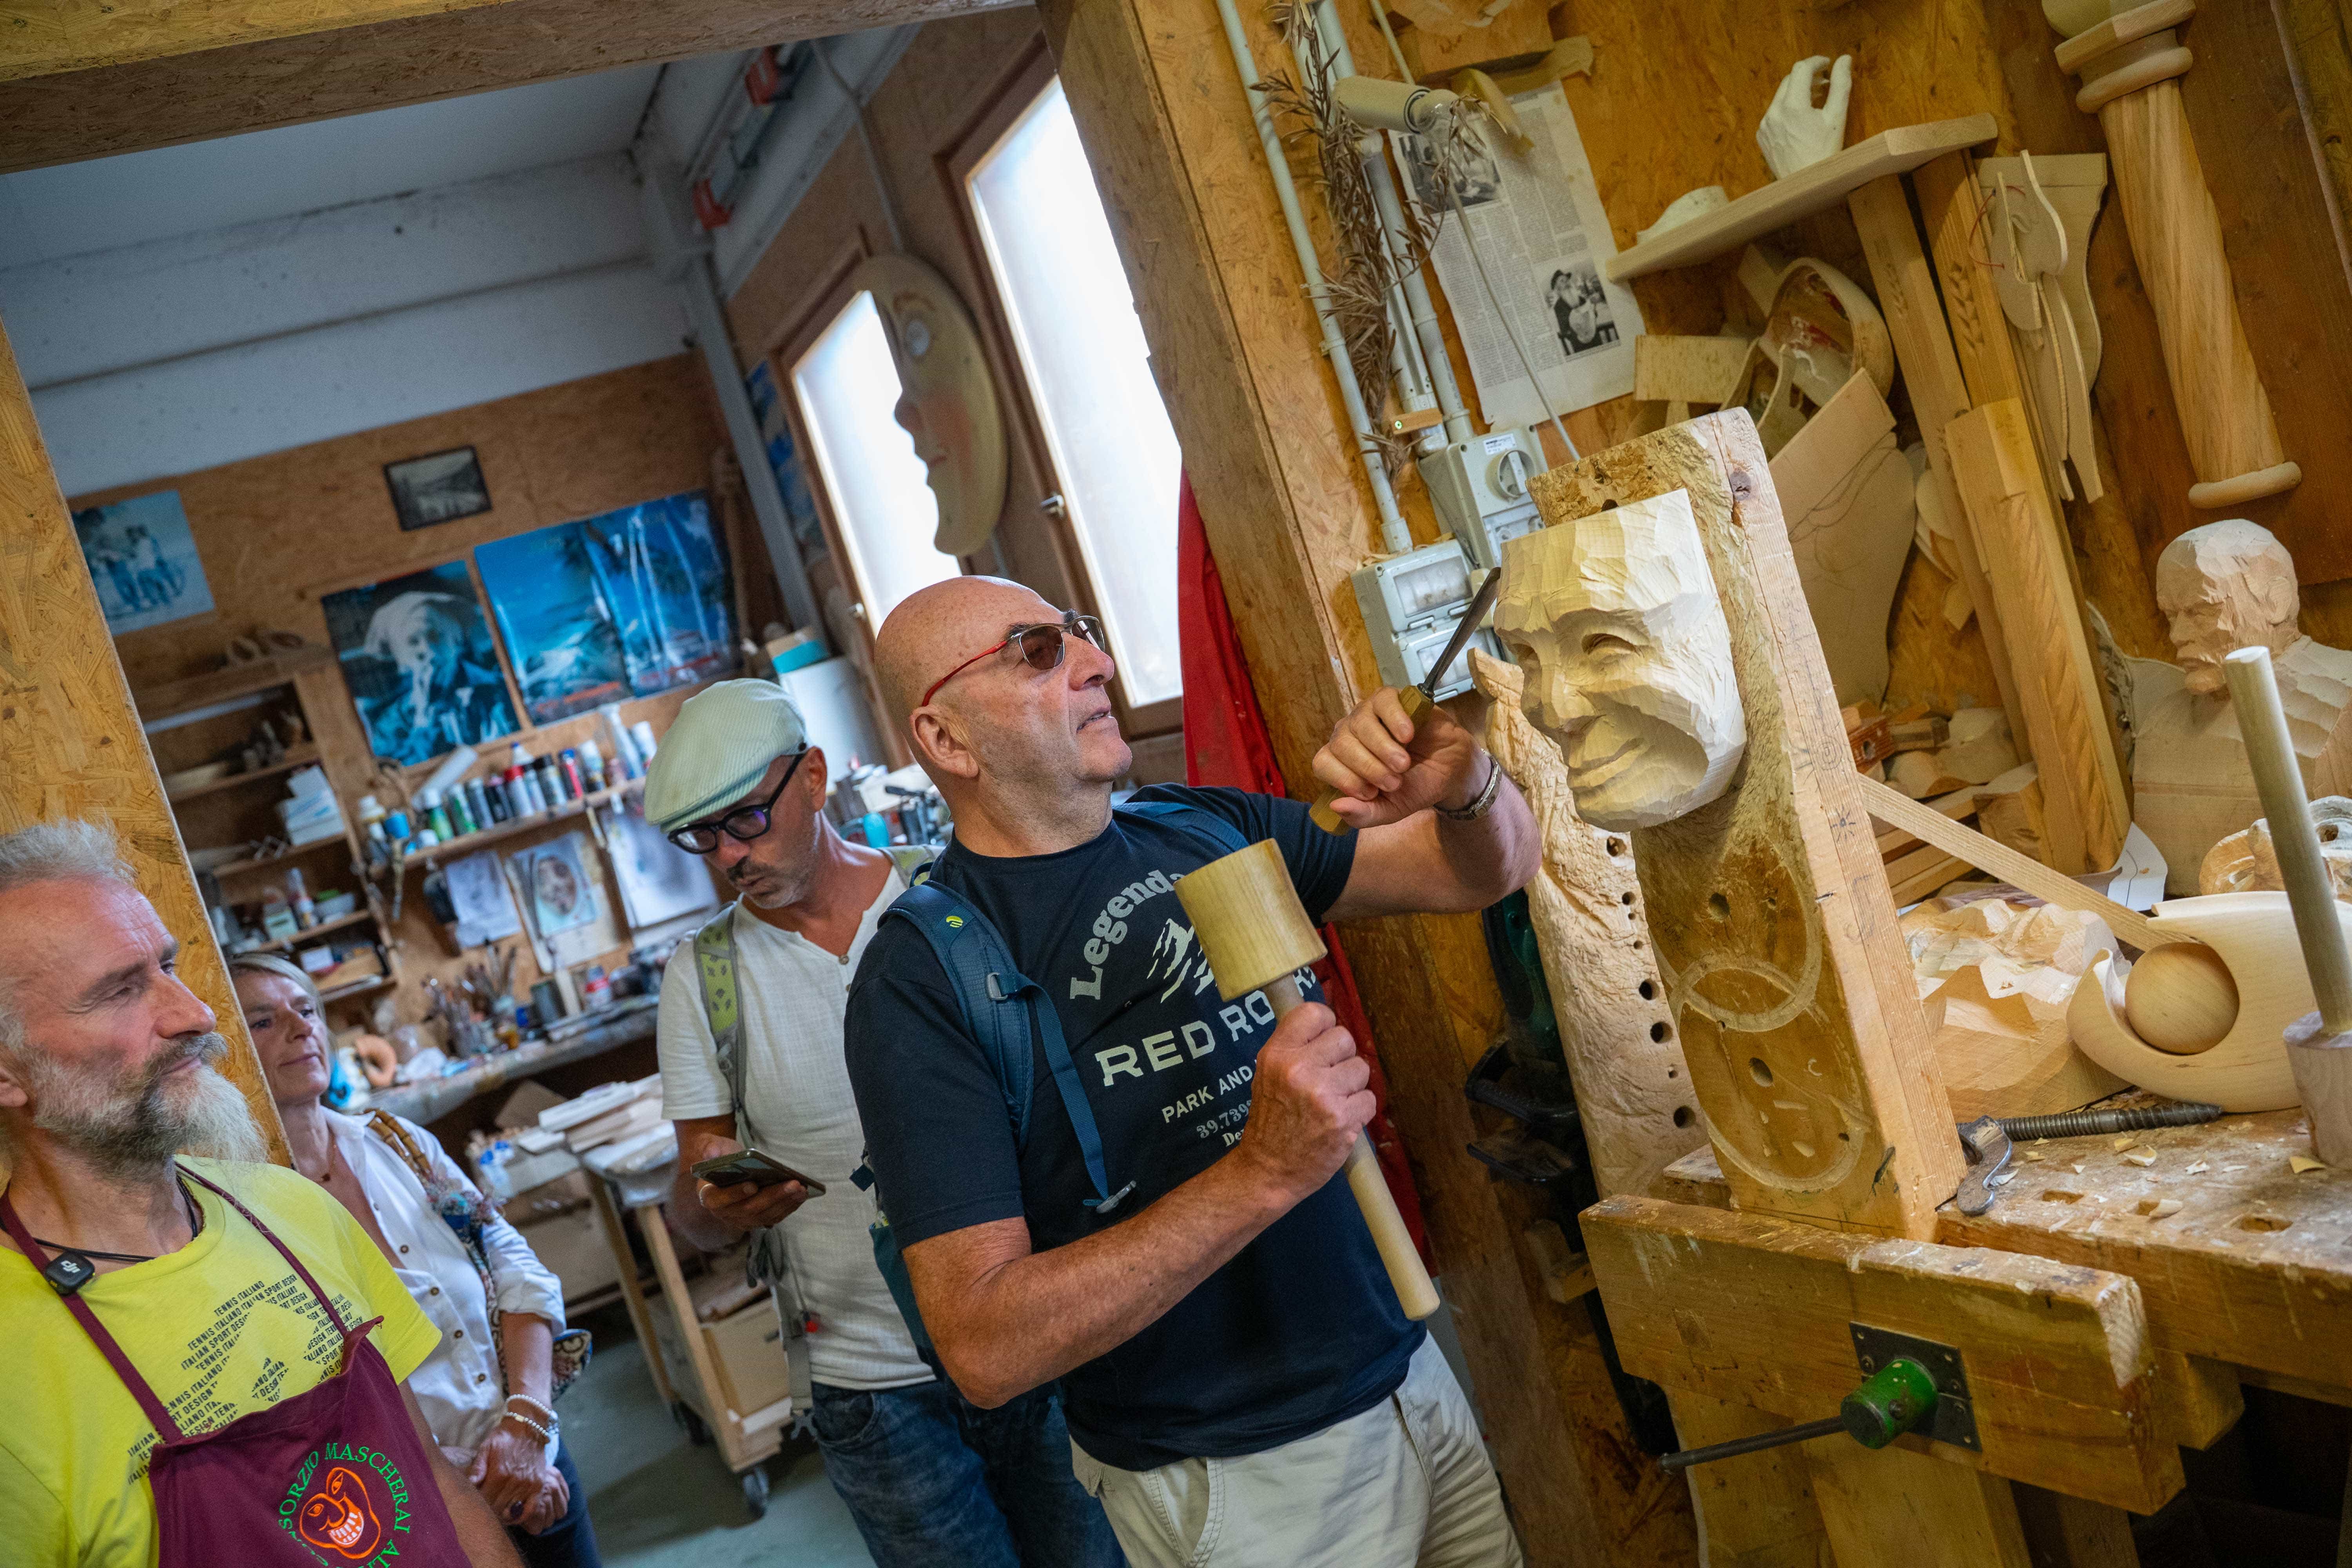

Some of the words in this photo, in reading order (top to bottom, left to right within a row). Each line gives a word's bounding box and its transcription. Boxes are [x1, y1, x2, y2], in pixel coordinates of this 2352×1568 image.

[1094, 1020, 1216, 1087] RED
[1218, 966, 1316, 1042] ROKS
[1161, 1086, 1214, 1123] PARK
[1219, 1065, 1253, 1096] AND
[187, 1327, 215, 1350] TENNIS
[214, 1307, 242, 1331] ITALIANO
[264, 1282, 283, 1296] SPORT
[214, 1297, 238, 1316] TENNIS
[237, 1280, 265, 1301] ITALIANO
[209, 1327, 232, 1348] SPORT
[321, 1348, 339, 1365] SPORT
[190, 1363, 223, 1393] ITALIANO
[182, 1388, 213, 1414] DESIGN
[324, 1442, 411, 1534] MASCHERAI
